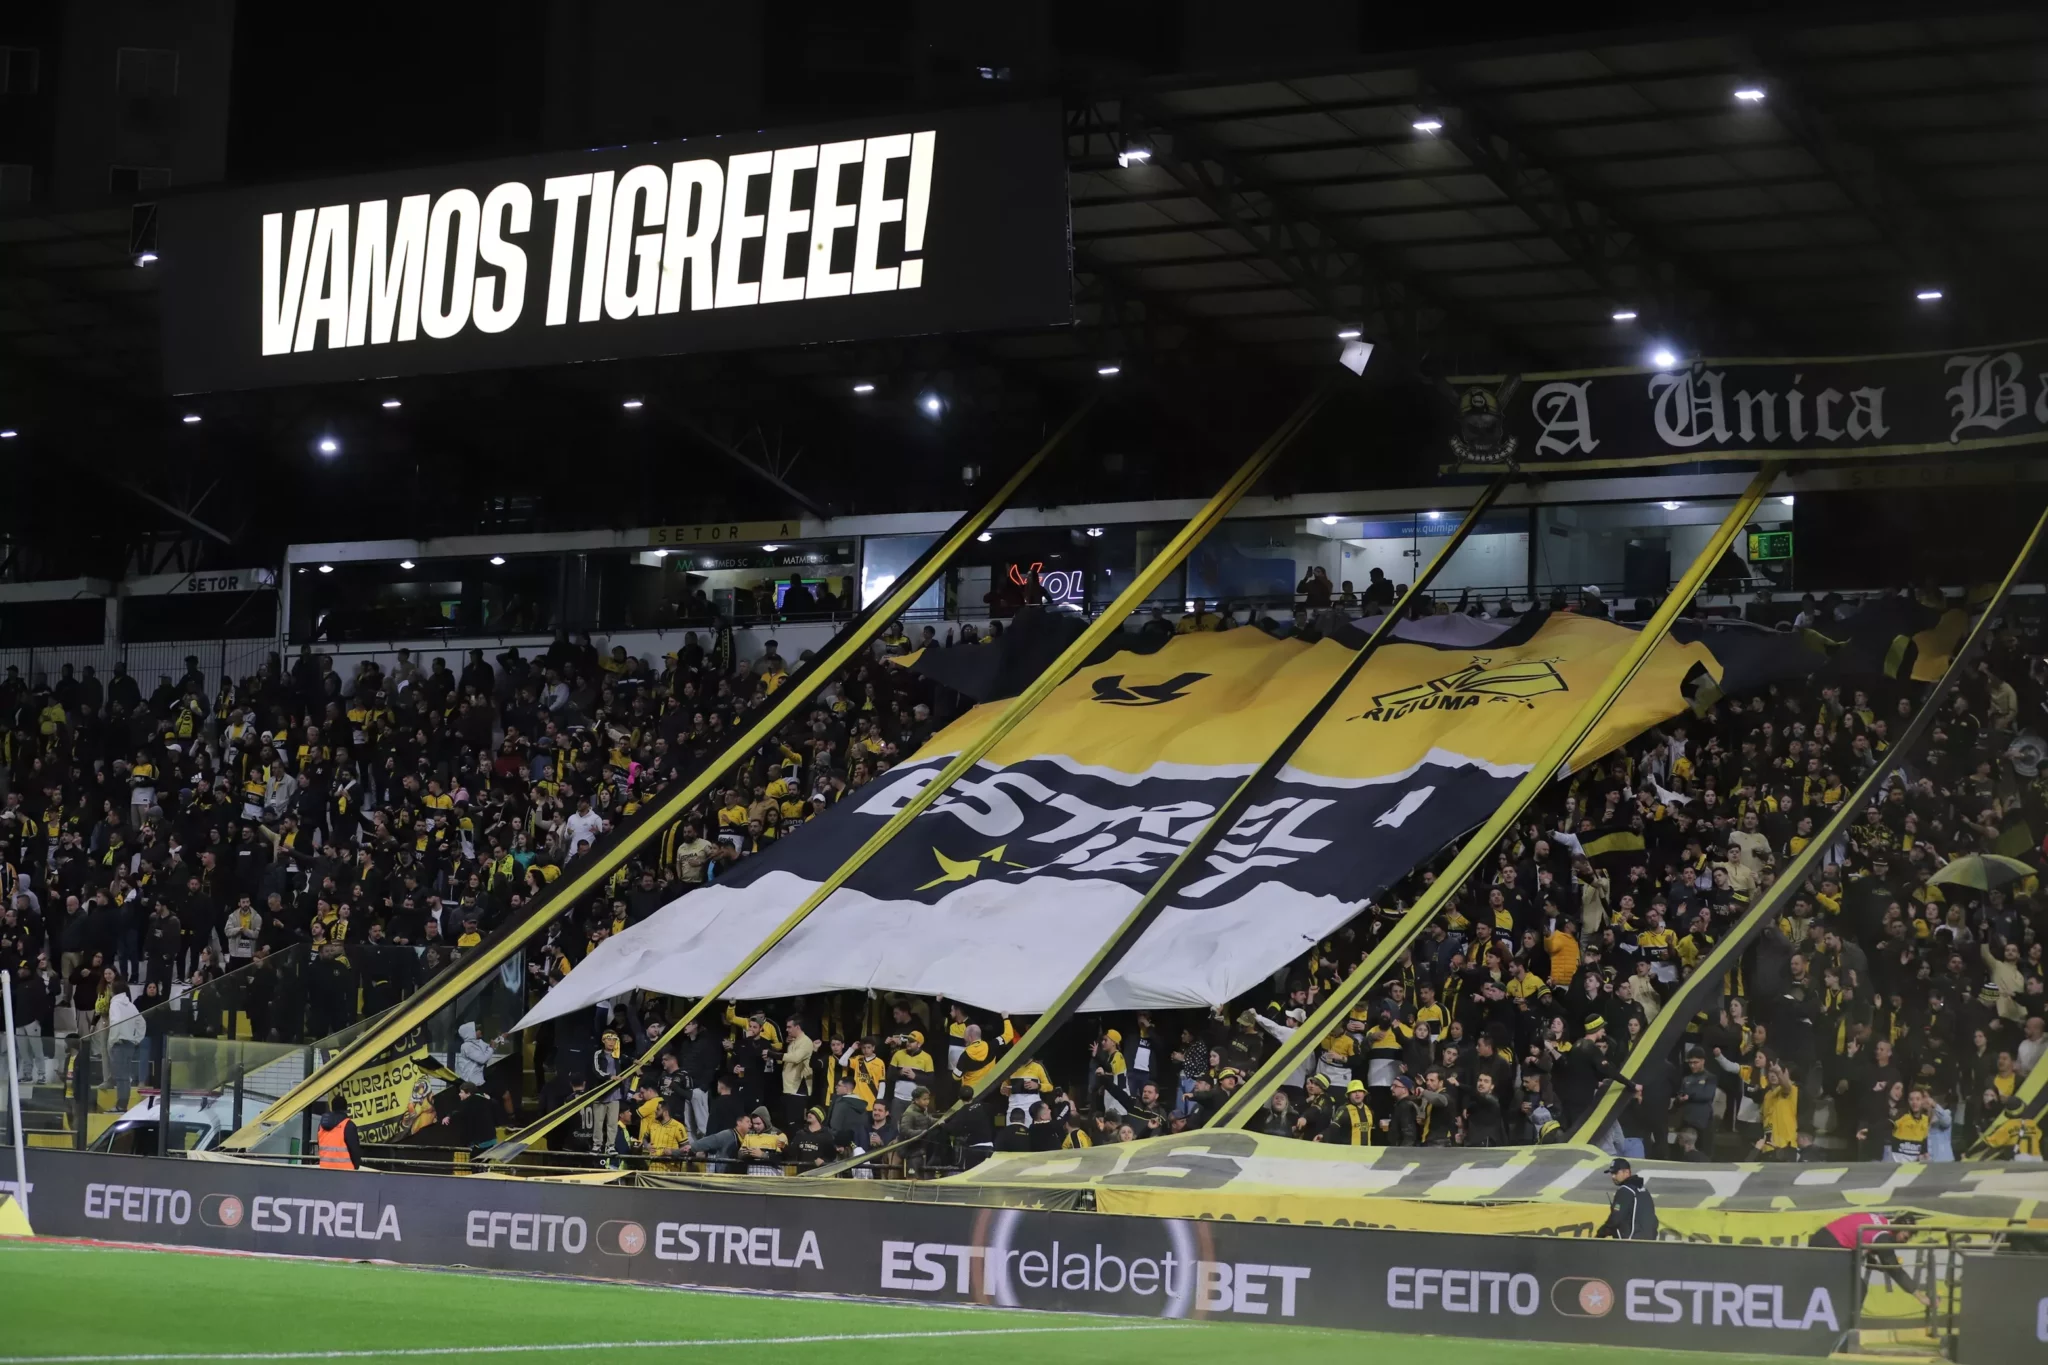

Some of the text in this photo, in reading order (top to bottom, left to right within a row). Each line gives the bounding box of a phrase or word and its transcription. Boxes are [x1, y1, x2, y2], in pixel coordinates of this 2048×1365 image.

[262, 130, 937, 356] VAMOS TIGREEEE!
[1532, 380, 1600, 456] A
[658, 523, 789, 542] SETOR A
[702, 559, 736, 569] MATMED
[782, 555, 818, 565] MATMED
[188, 576, 239, 592] SETOR
[346, 1091, 401, 1119] ERVEJA
[580, 1106, 593, 1130] 10
[1366, 1146, 2048, 1220] TIGRE
[84, 1182, 192, 1225] EFEITO
[250, 1195, 402, 1242] ESTRELA
[466, 1209, 824, 1271] EFEITO ESTRELA
[1386, 1266, 1840, 1333] EFEITO ESTRELA
